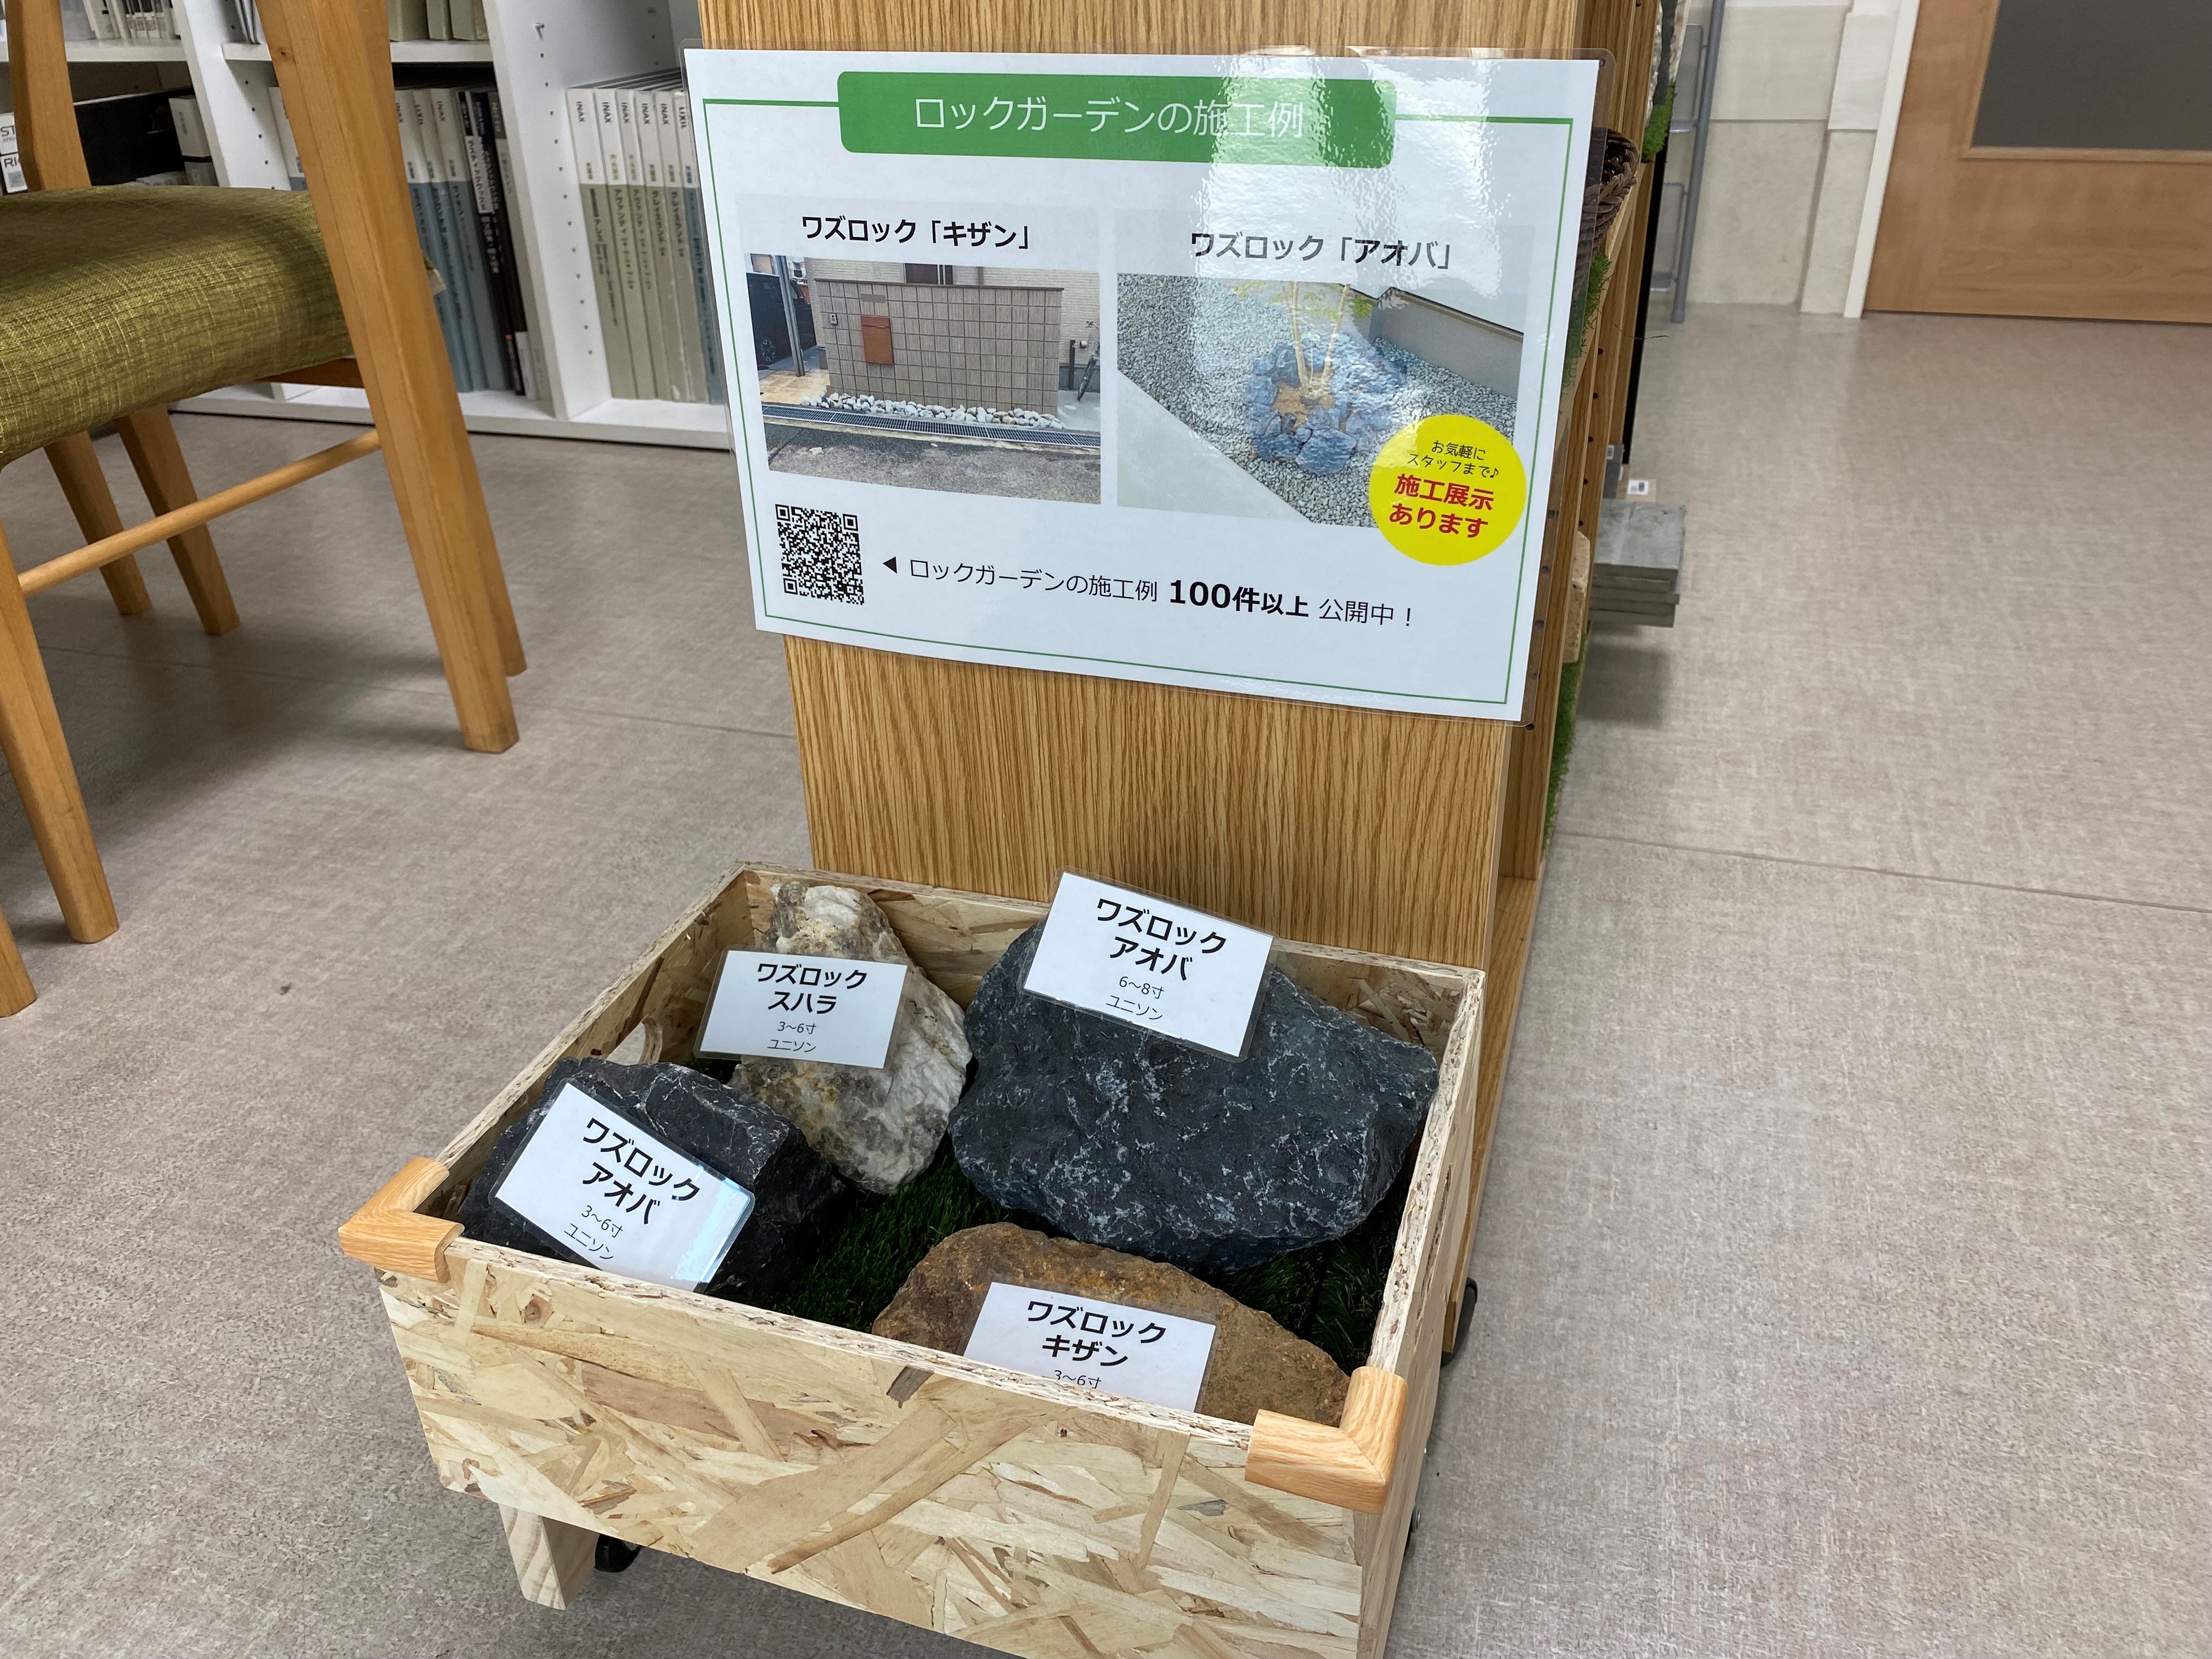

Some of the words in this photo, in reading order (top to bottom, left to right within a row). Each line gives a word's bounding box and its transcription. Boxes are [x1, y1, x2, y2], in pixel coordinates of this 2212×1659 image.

[576, 101, 585, 123] INAX
[602, 101, 612, 123] INAX
[621, 102, 630, 124] INAX
[642, 103, 650, 125] INAX
[660, 103, 669, 126] INAX
[678, 106, 687, 129] LIXIL
[915, 95, 1305, 139] ロックガーデンの施工例
[802, 215, 1028, 250] ワズロック「キザン」
[1192, 231, 1451, 269] ワズロック「アオバ」
[1431, 440, 1486, 460] お気軽に
[1394, 473, 1494, 511] 施工展示
[1389, 503, 1488, 538] あります
[910, 559, 1158, 602] ロックガーデンの施工例
[1170, 579, 1309, 617] 100件以上
[1097, 898, 1227, 953] ワズロック
[1110, 936, 1193, 981] アオバ
[758, 963, 867, 989] ワズロック
[1119, 976, 1165, 1000] 6～8寸
[768, 991, 837, 1014] スハラ
[1106, 995, 1163, 1020] ユニソン
[777, 1021, 816, 1035] 3～6寸
[767, 1039, 816, 1052] ユニソン
[583, 1118, 700, 1201] ワズロック
[583, 1161, 661, 1224] アオバ
[581, 1205, 623, 1238] 3～6寸
[563, 1223, 614, 1260] ユニソン
[1028, 1301, 1166, 1344] ワズロック
[1042, 1334, 1128, 1366] キザン
